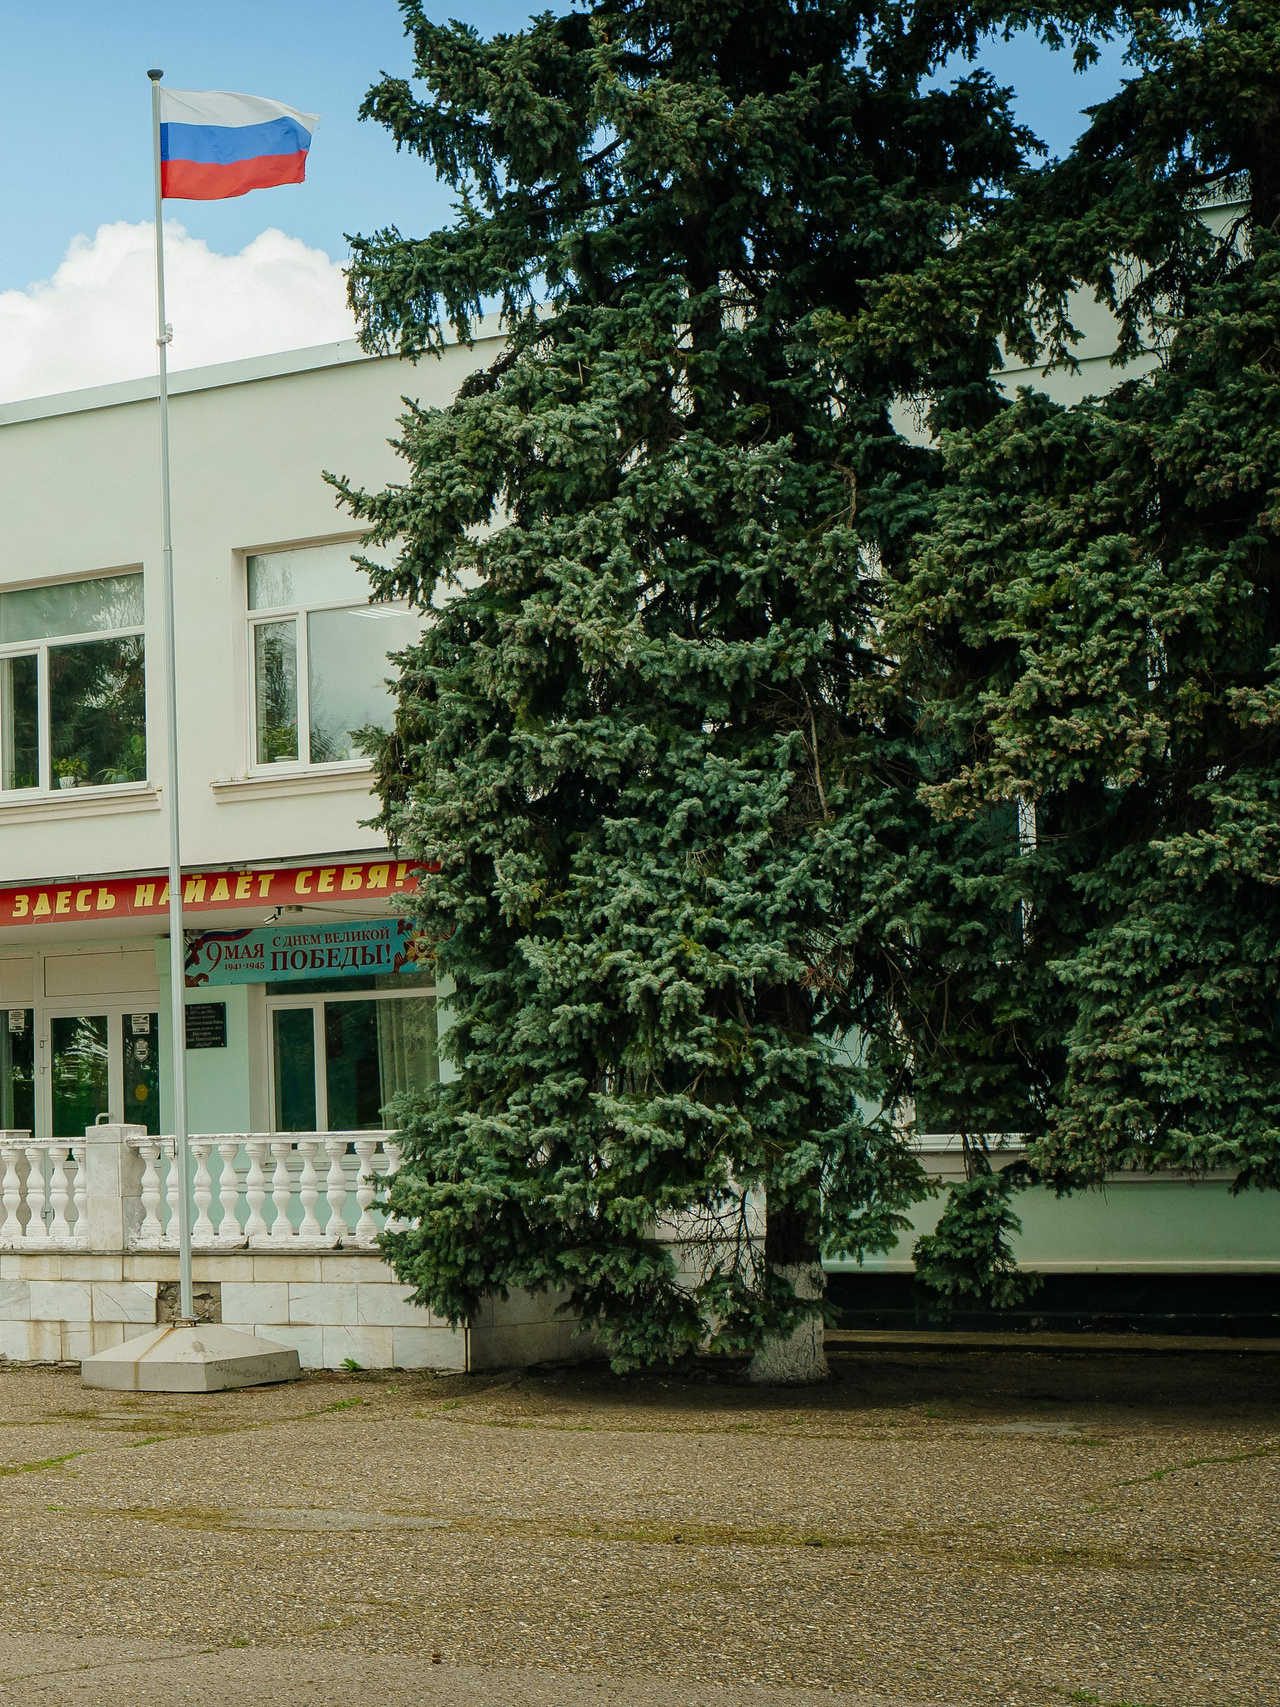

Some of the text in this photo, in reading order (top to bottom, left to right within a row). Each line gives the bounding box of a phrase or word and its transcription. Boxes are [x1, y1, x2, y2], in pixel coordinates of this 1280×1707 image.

[12, 887, 117, 918] ЗДЕСЬ
[293, 863, 408, 896] СЕБЯ!
[272, 926, 390, 948] С ДНЕМ ВЕЛИКОЙ
[206, 942, 265, 973] 9 МАЯ
[223, 961, 266, 971] 1941-1945
[270, 943, 392, 972] ПОБЕДЫ!
